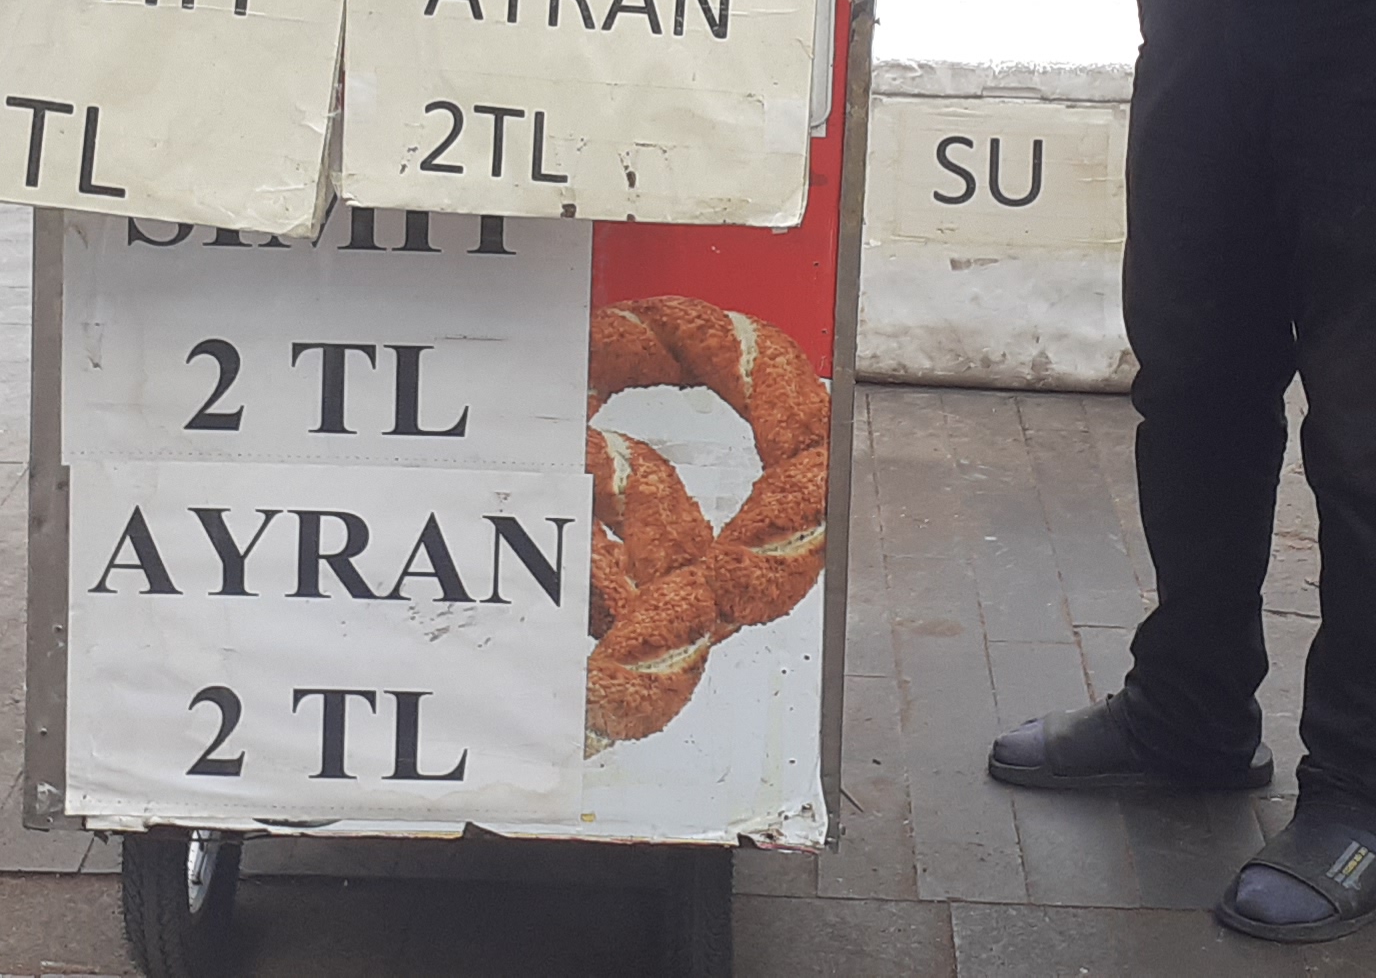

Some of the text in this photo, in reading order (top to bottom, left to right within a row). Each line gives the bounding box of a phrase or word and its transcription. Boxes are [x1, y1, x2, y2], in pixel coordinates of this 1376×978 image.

[419, 100, 569, 184] 2TL
[933, 136, 1043, 208] SU
[183, 338, 470, 438] 2 TL
[87, 505, 575, 608] AYRAN
[186, 686, 468, 782] 2 TL
